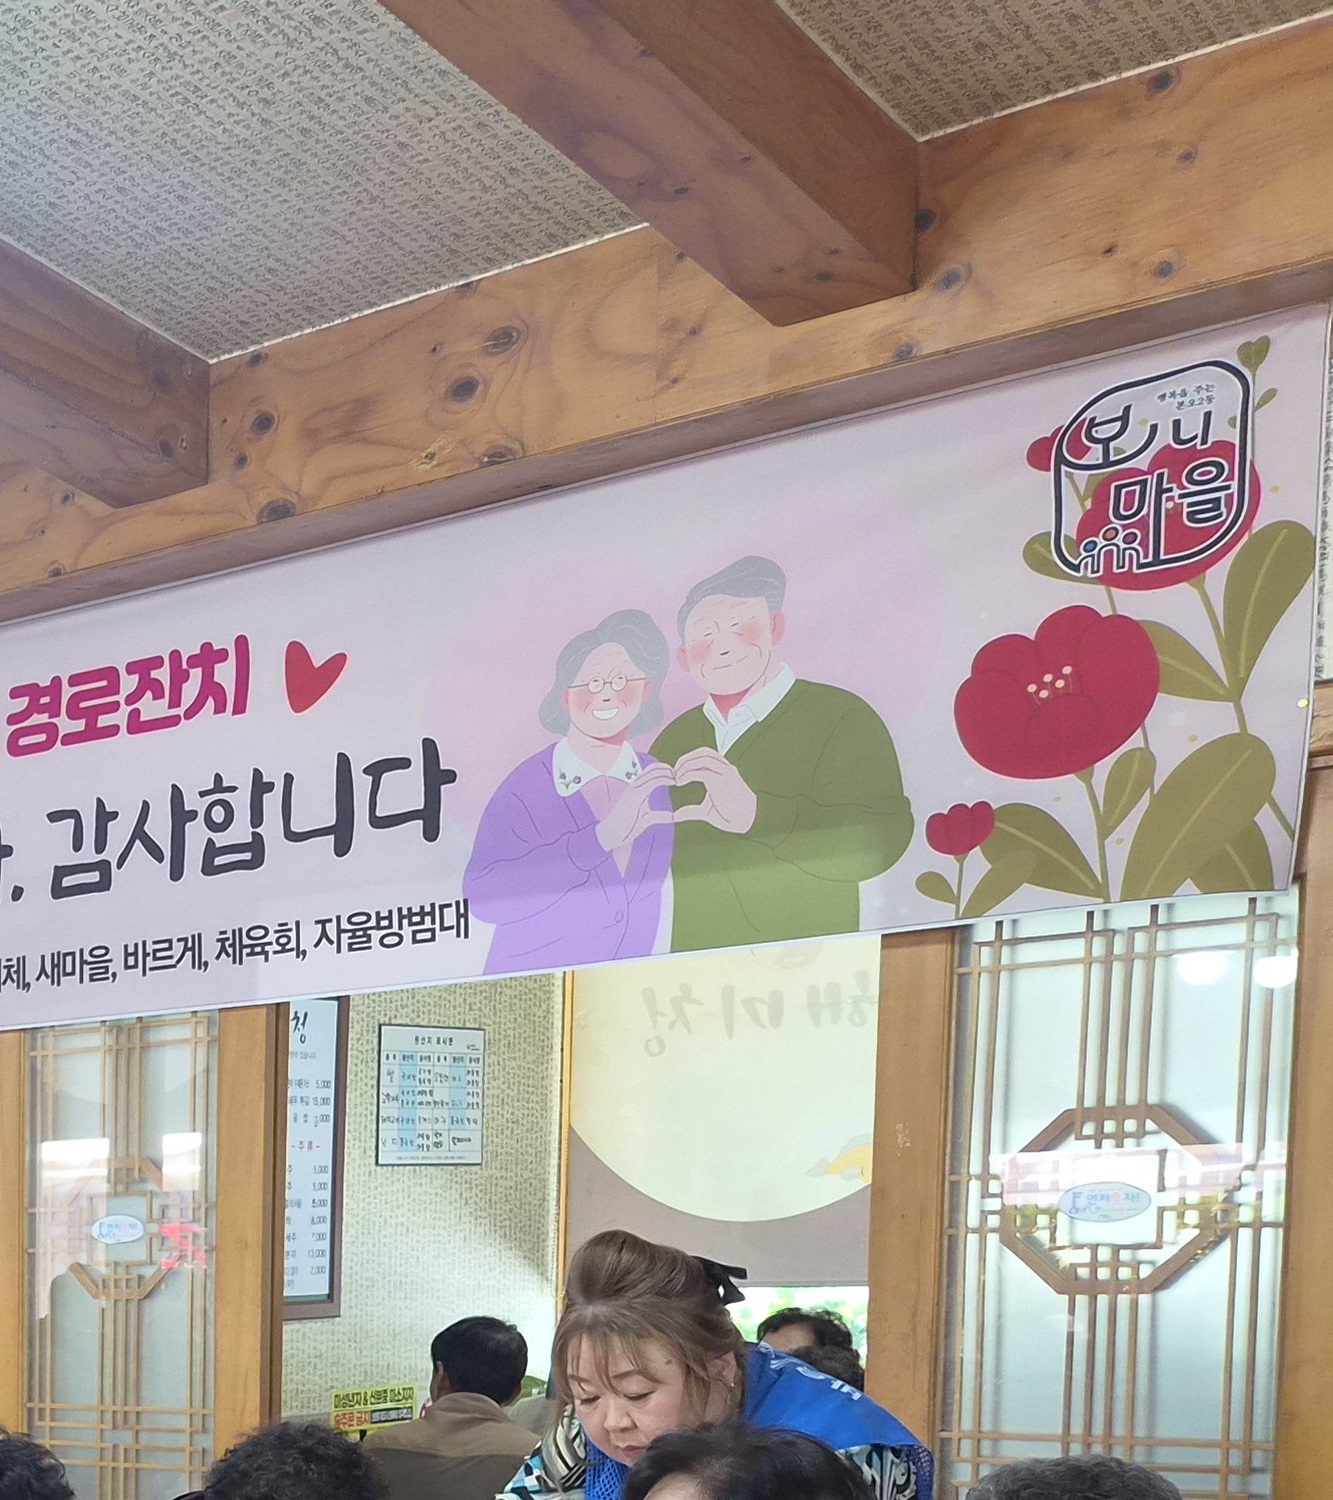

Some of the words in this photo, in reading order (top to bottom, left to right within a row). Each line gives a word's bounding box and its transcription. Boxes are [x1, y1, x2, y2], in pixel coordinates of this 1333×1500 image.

[1175, 395, 1216, 410] 본오2동
[1111, 459, 1232, 556] 마을
[5, 633, 251, 759] 경로잔치
[49, 737, 458, 900] 감사합니다
[35, 945, 117, 987] 새마을,
[123, 931, 209, 977] 바르게,
[214, 919, 307, 967] 체육회,
[313, 898, 470, 955] 자율방범대
[315, 1080, 332, 1089] 5,000
